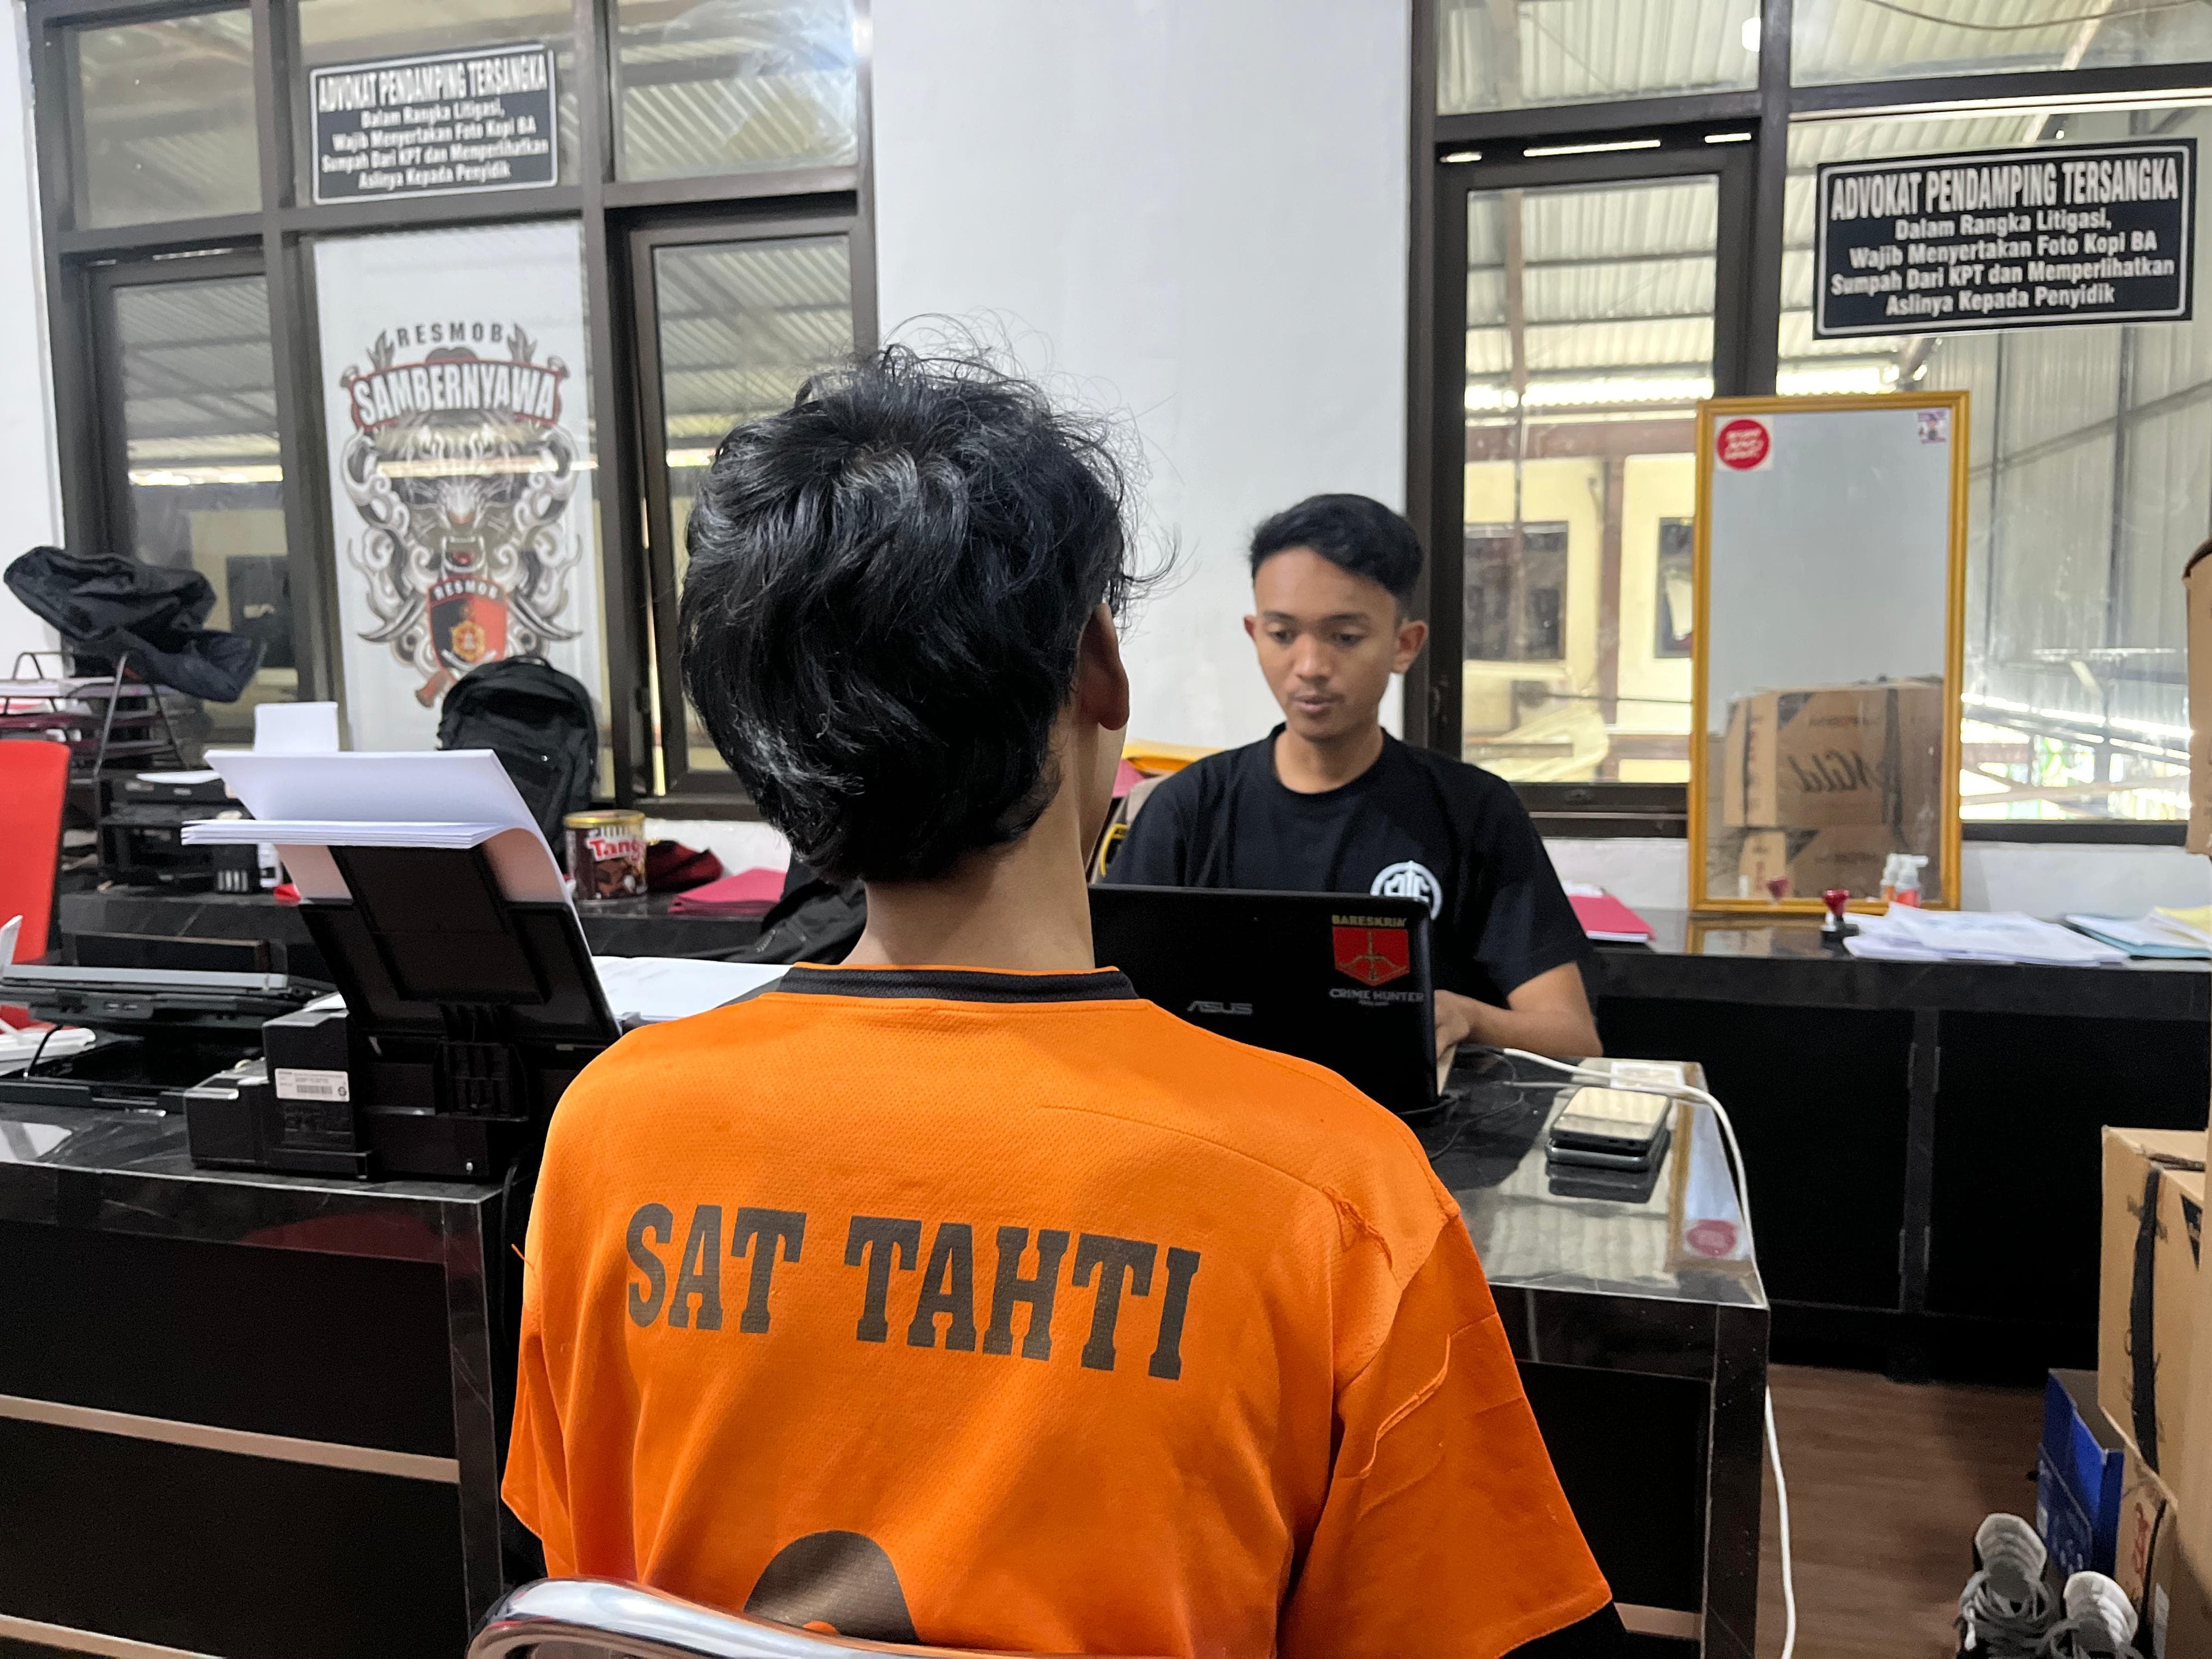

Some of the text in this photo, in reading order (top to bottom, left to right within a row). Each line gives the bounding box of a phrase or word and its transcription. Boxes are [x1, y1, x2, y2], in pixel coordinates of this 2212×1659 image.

[318, 54, 547, 113] ADVOKAT PENDAMPING TERSANGKA
[403, 104, 452, 128] Rangka
[454, 122, 484, 141] Foto
[517, 115, 537, 135] BA
[398, 146, 423, 166] KPT
[423, 145, 449, 164] dan
[1831, 157, 2179, 221] ADVOKAT PENDAMPING TERSANGKA
[1895, 207, 2112, 241] Dalam Rangka Litigasi,
[1849, 230, 2157, 271] Wajib Menyertakan Foto Kopi BA
[1831, 256, 2175, 297] Sumpah Dari KPT dan Memperlihatkan
[1885, 283, 2115, 317] Aslinya Kepada Penyidik
[396, 321, 505, 347] RESMOB
[353, 363, 555, 426] SAMBERNYAWA
[433, 579, 498, 600] RESMOB
[1188, 1001, 1252, 1016] ASUS
[1328, 988, 1371, 1000] CRIME
[1373, 990, 1424, 1002] HUNTER
[626, 1202, 1201, 1381] SAT TAHTI
